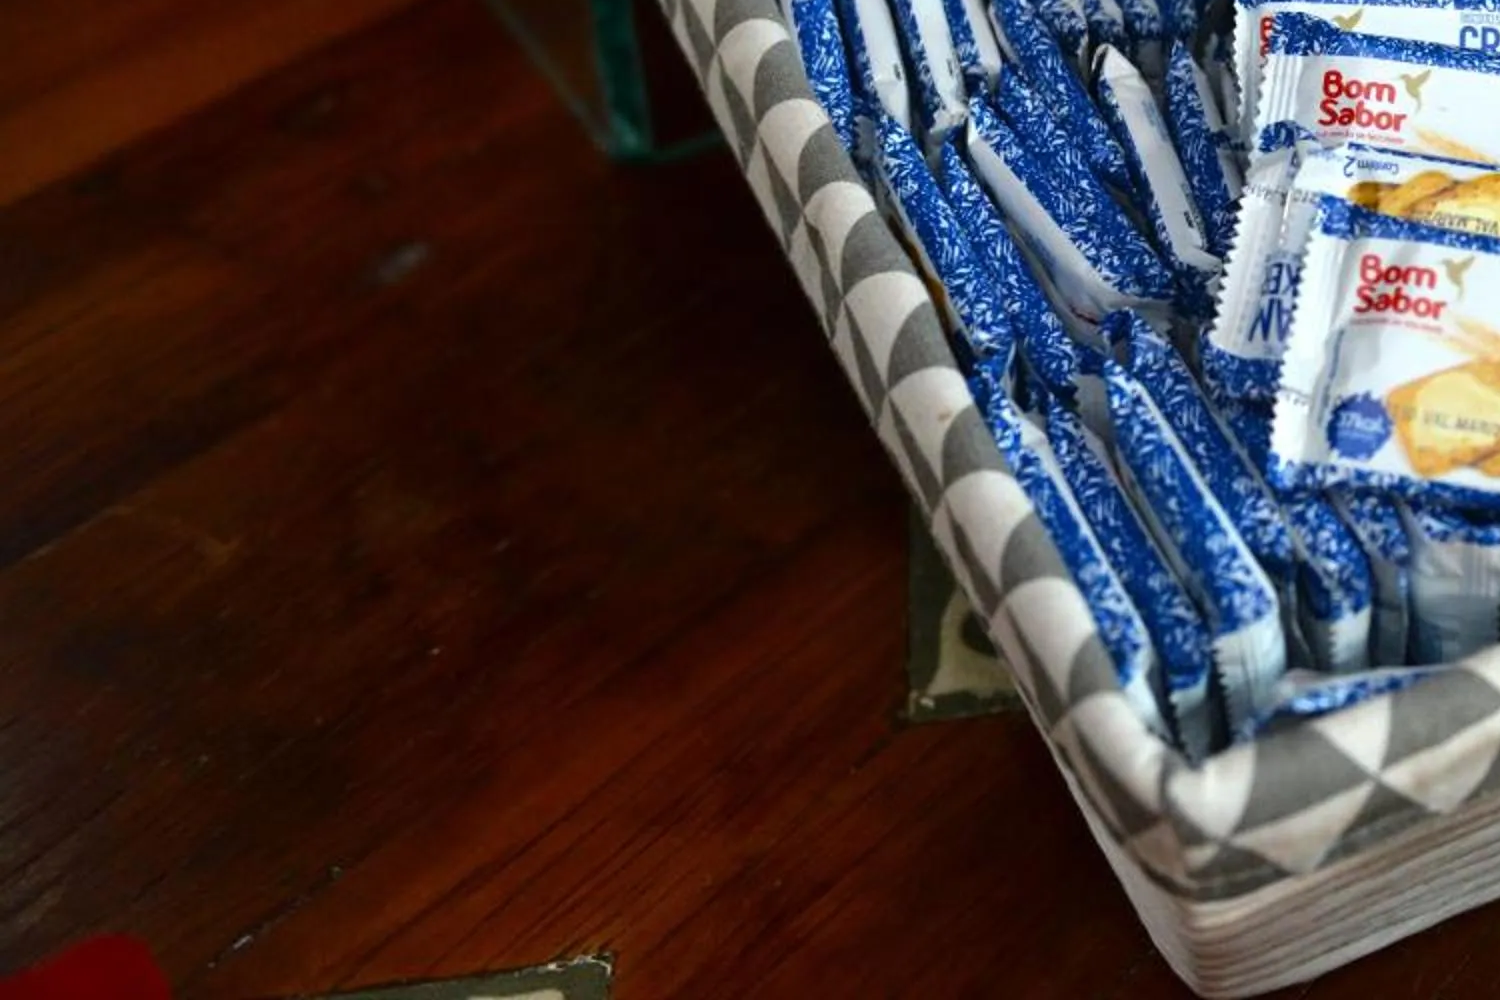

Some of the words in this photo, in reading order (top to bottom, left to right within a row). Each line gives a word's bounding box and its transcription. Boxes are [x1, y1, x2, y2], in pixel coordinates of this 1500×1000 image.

[1322, 70, 1396, 104] Bom
[1318, 99, 1407, 131] Sabor
[1343, 155, 1357, 178] 2
[1360, 254, 1437, 290] Bom
[1354, 285, 1447, 320] Sabor
